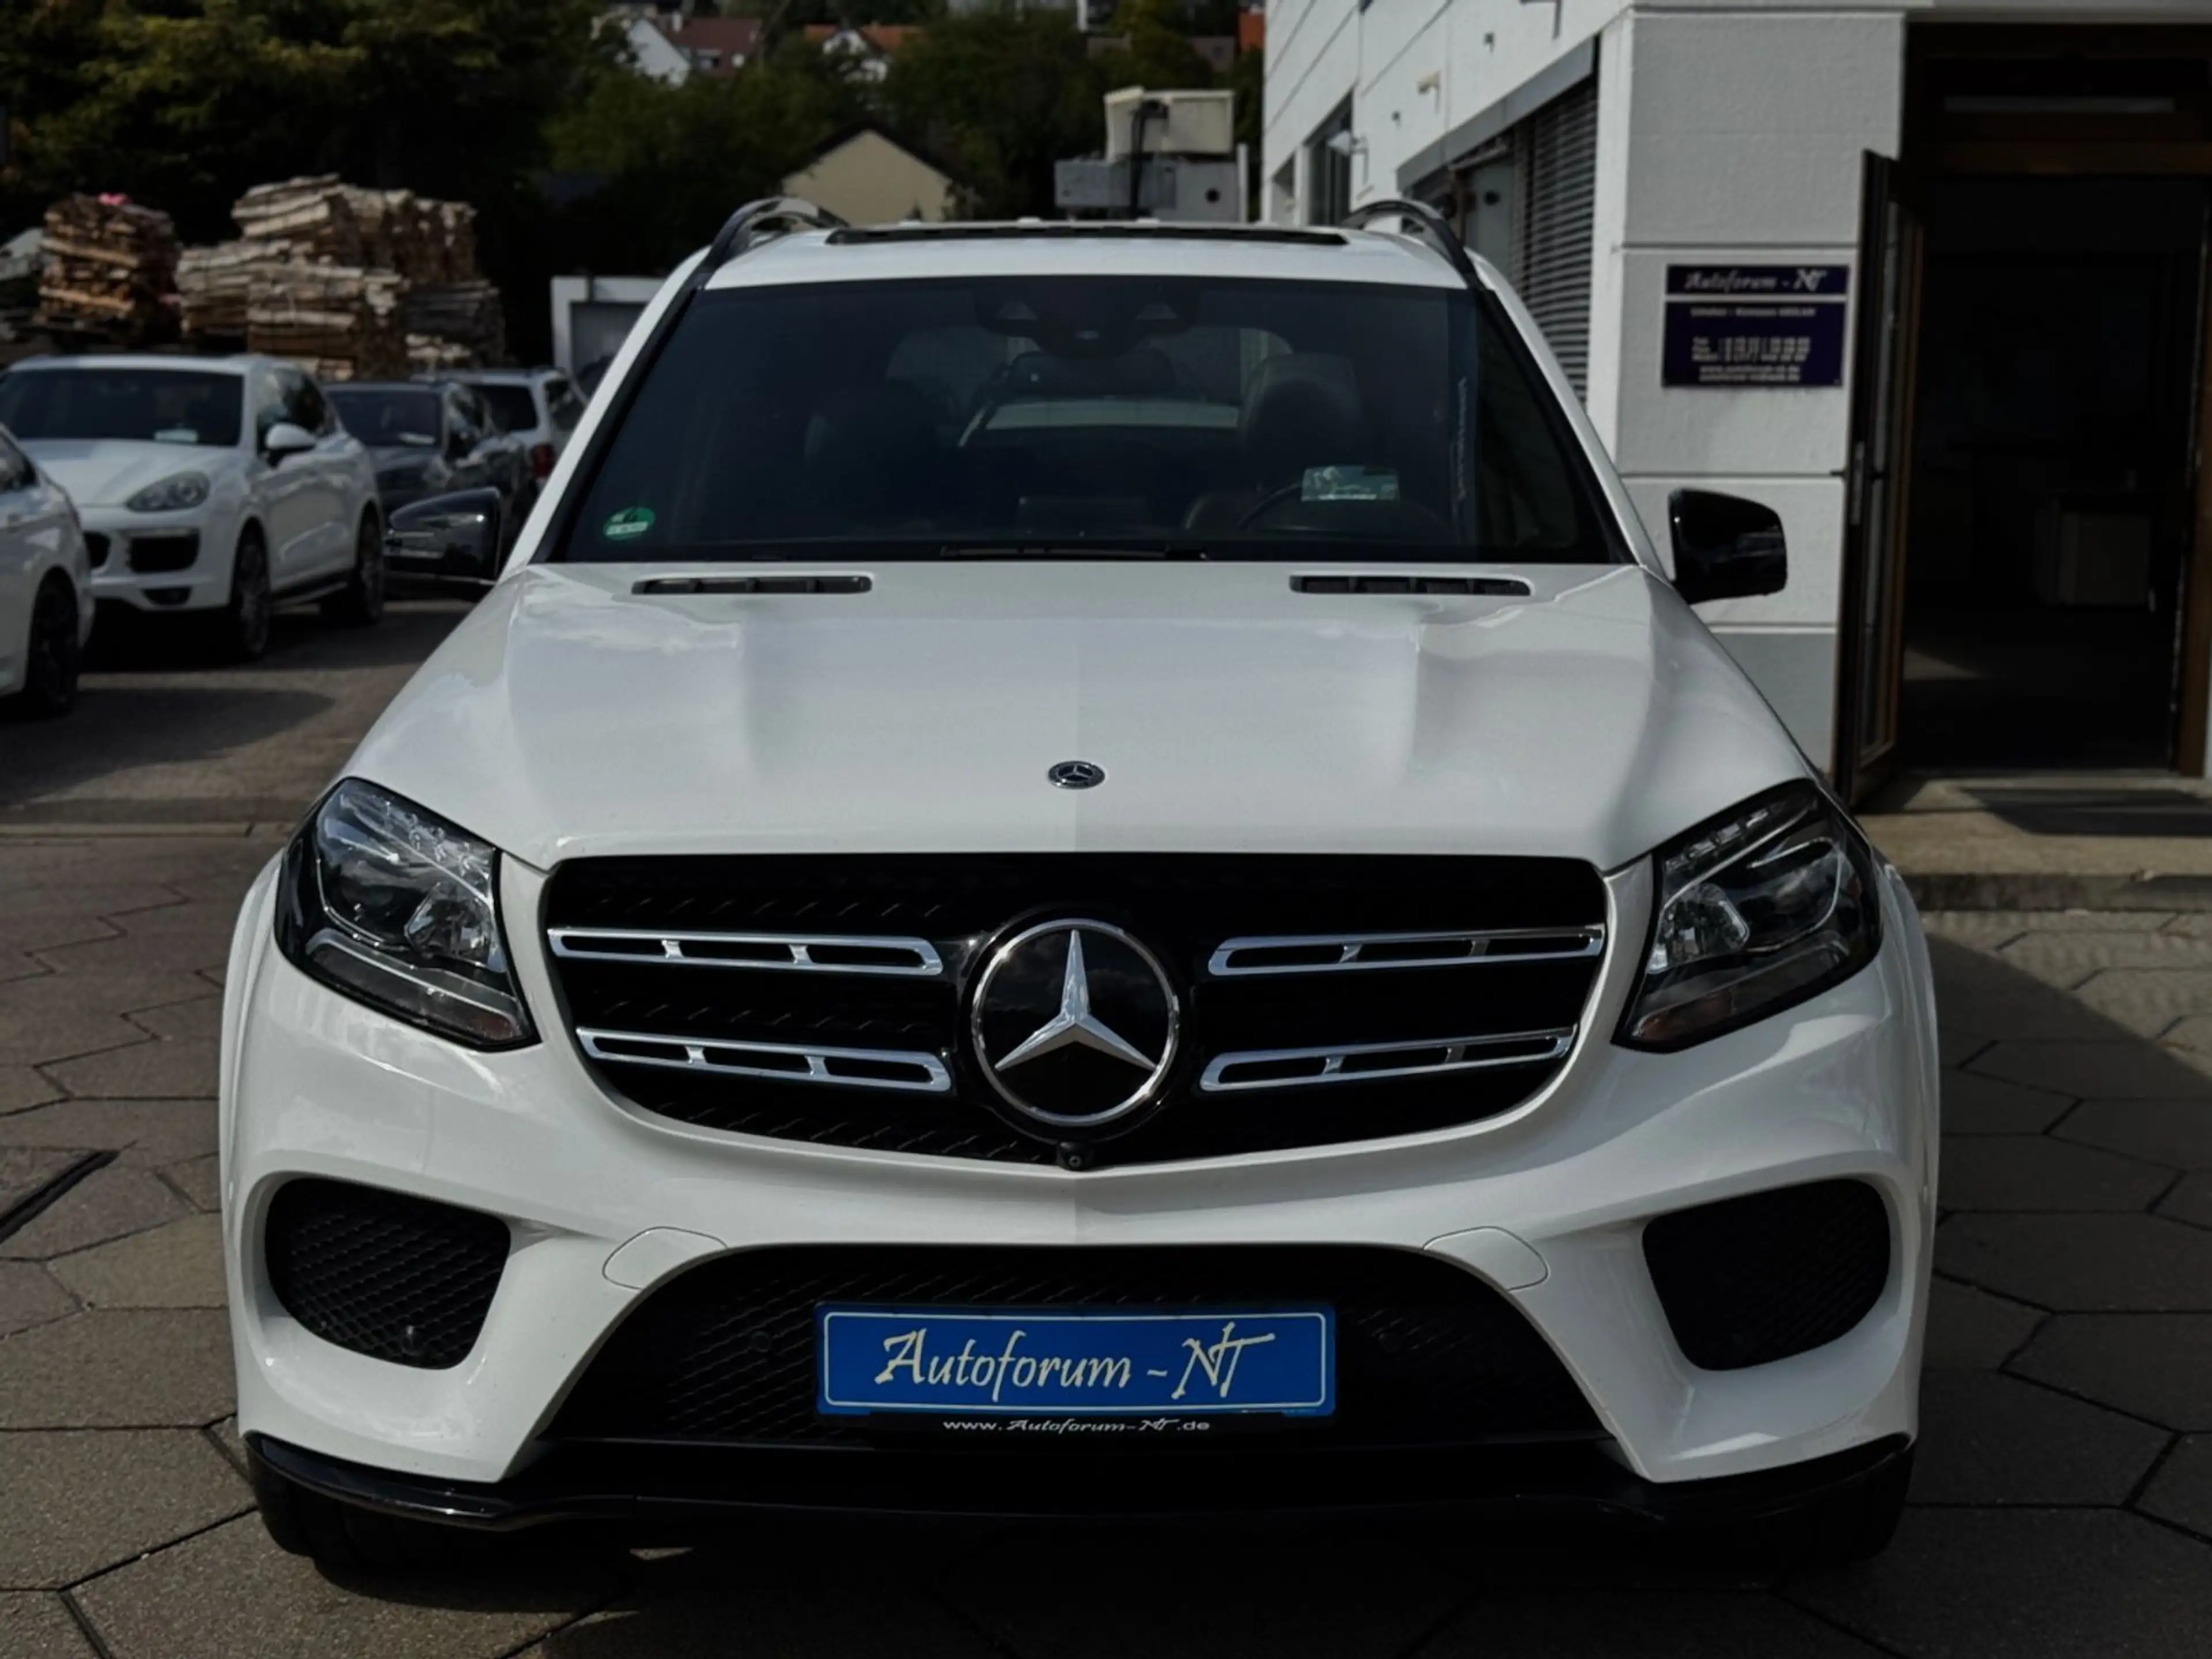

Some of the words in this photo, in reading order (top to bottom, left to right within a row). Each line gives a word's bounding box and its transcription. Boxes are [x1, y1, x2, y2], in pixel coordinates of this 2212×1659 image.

[874, 1327, 1131, 1403] Autoforum
[1171, 1321, 1276, 1400] NT
[942, 1417, 1210, 1435] www.Autoforum-NT.de
